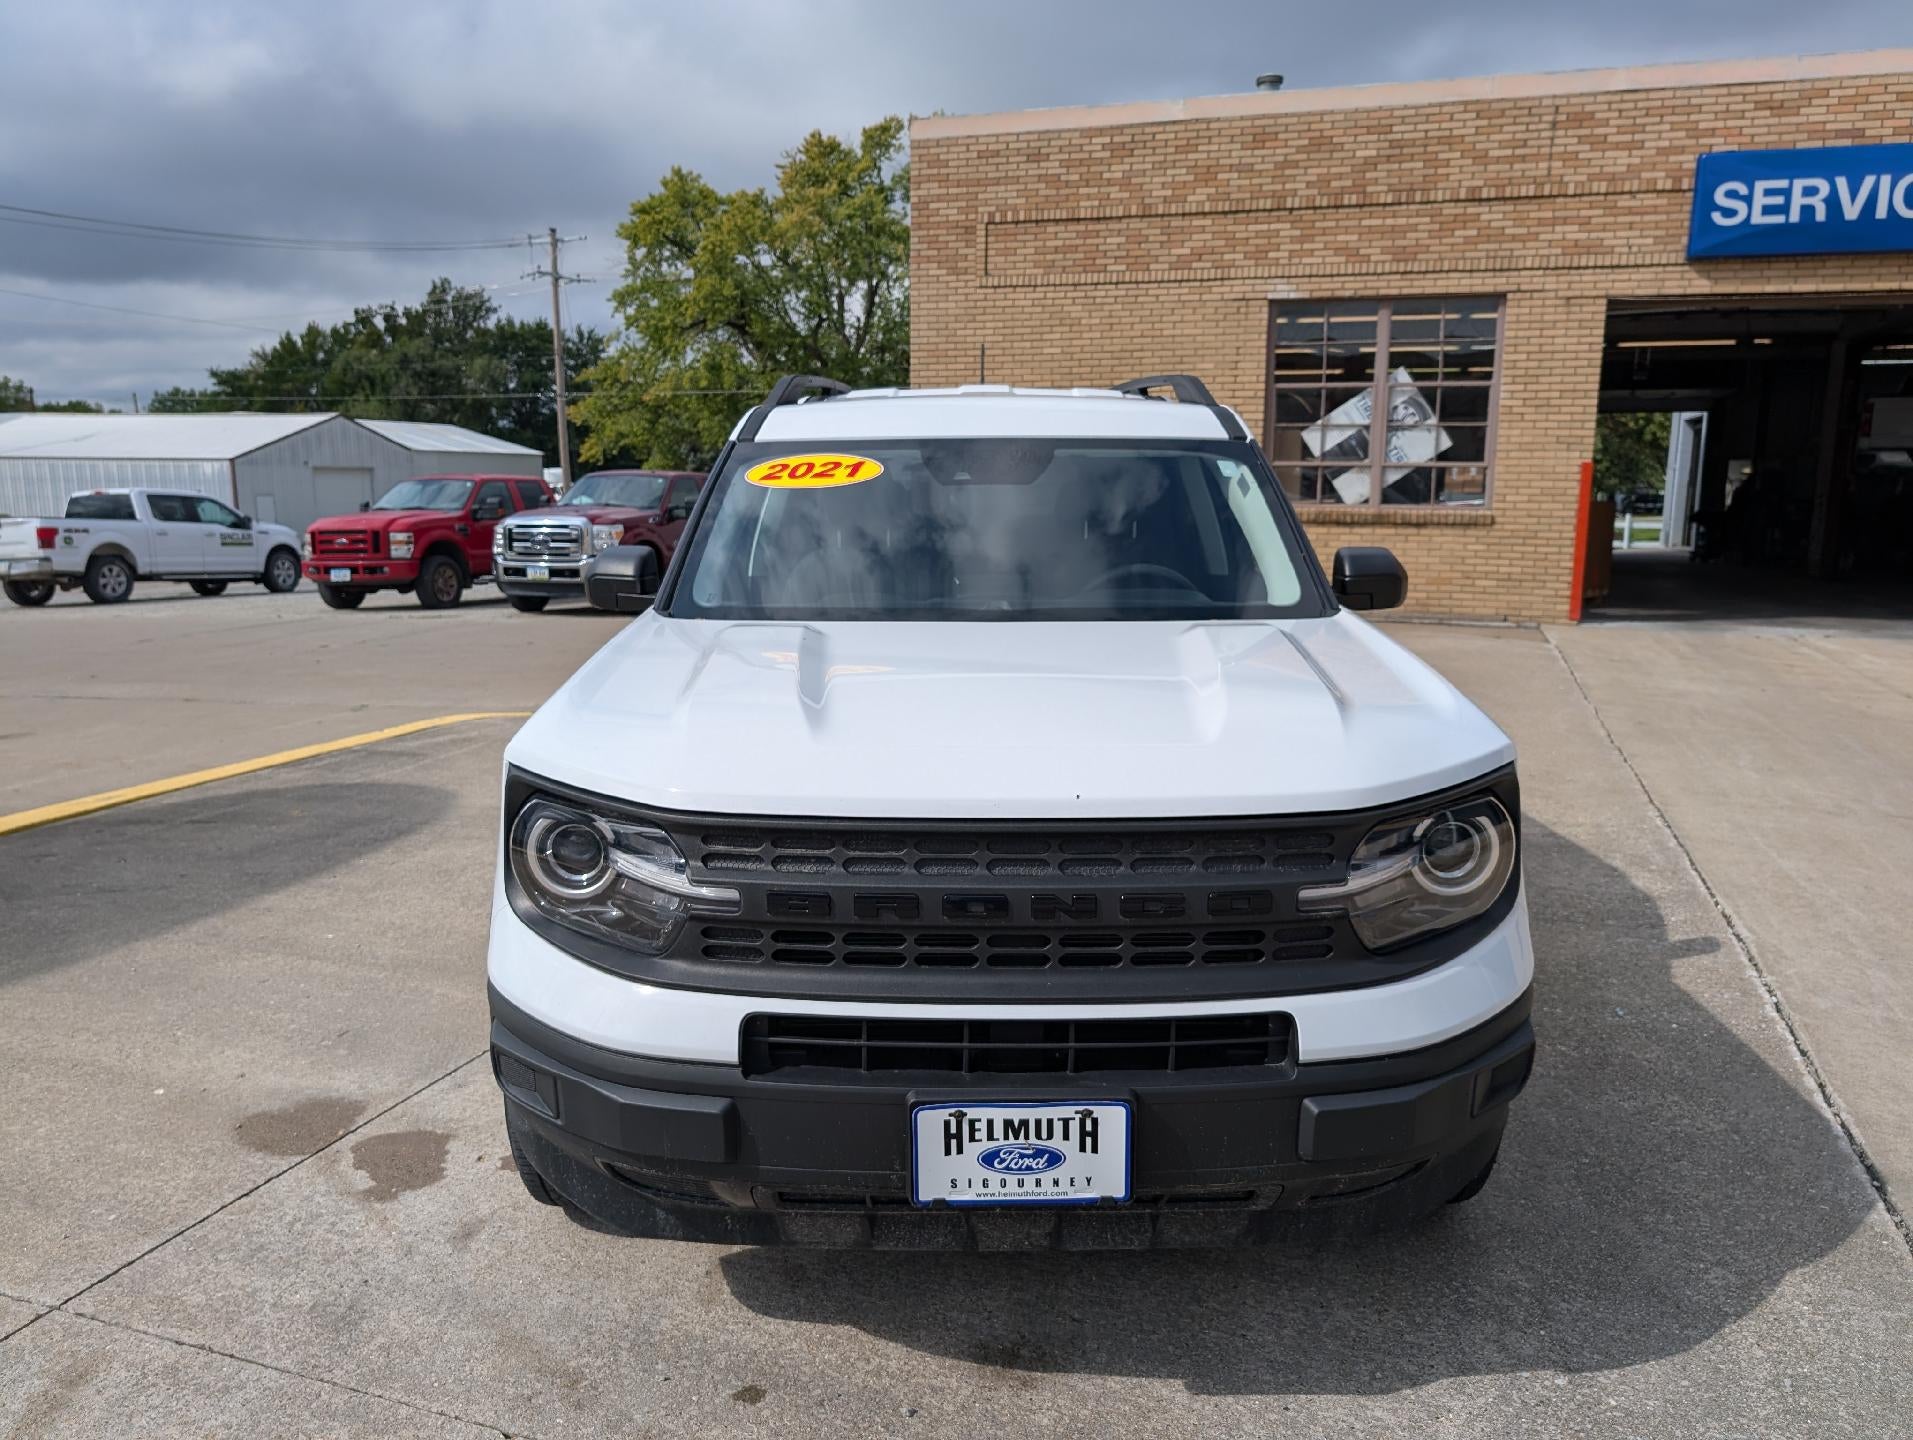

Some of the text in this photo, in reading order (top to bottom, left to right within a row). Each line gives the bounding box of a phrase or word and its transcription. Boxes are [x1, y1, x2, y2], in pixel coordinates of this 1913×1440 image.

[758, 460, 867, 481] 2021
[766, 889, 1273, 919] BRONCO
[943, 1115, 1099, 1157] HELMUTH
[993, 1147, 1049, 1169] Ford
[950, 1176, 1093, 1189] SIGOURNEY
[975, 1189, 1069, 1198] www.helmuthford.com
